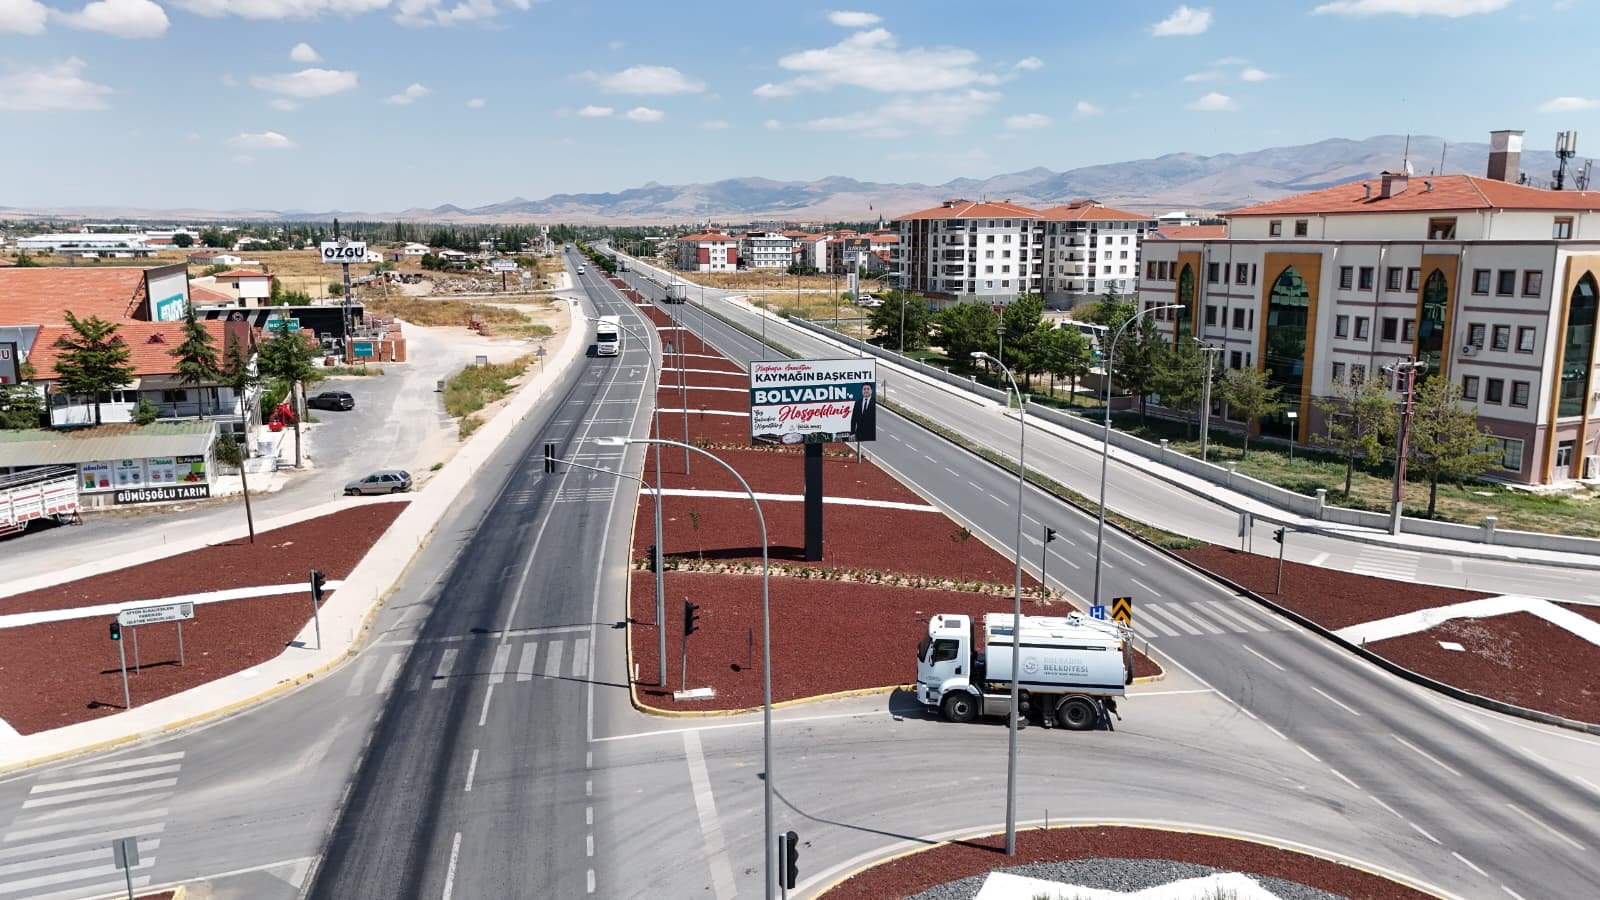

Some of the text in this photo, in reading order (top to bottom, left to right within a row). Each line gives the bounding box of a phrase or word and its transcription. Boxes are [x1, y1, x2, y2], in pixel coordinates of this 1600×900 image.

[756, 371, 872, 382] KAYMAĞIN BAŞKENTİ
[778, 404, 851, 422] Hoşgeldiniz
[118, 487, 207, 502] GÜMÜŞOĞLU TARIM
[1092, 608, 1102, 618] H
[1043, 664, 1089, 672] BELEDİYESİ
